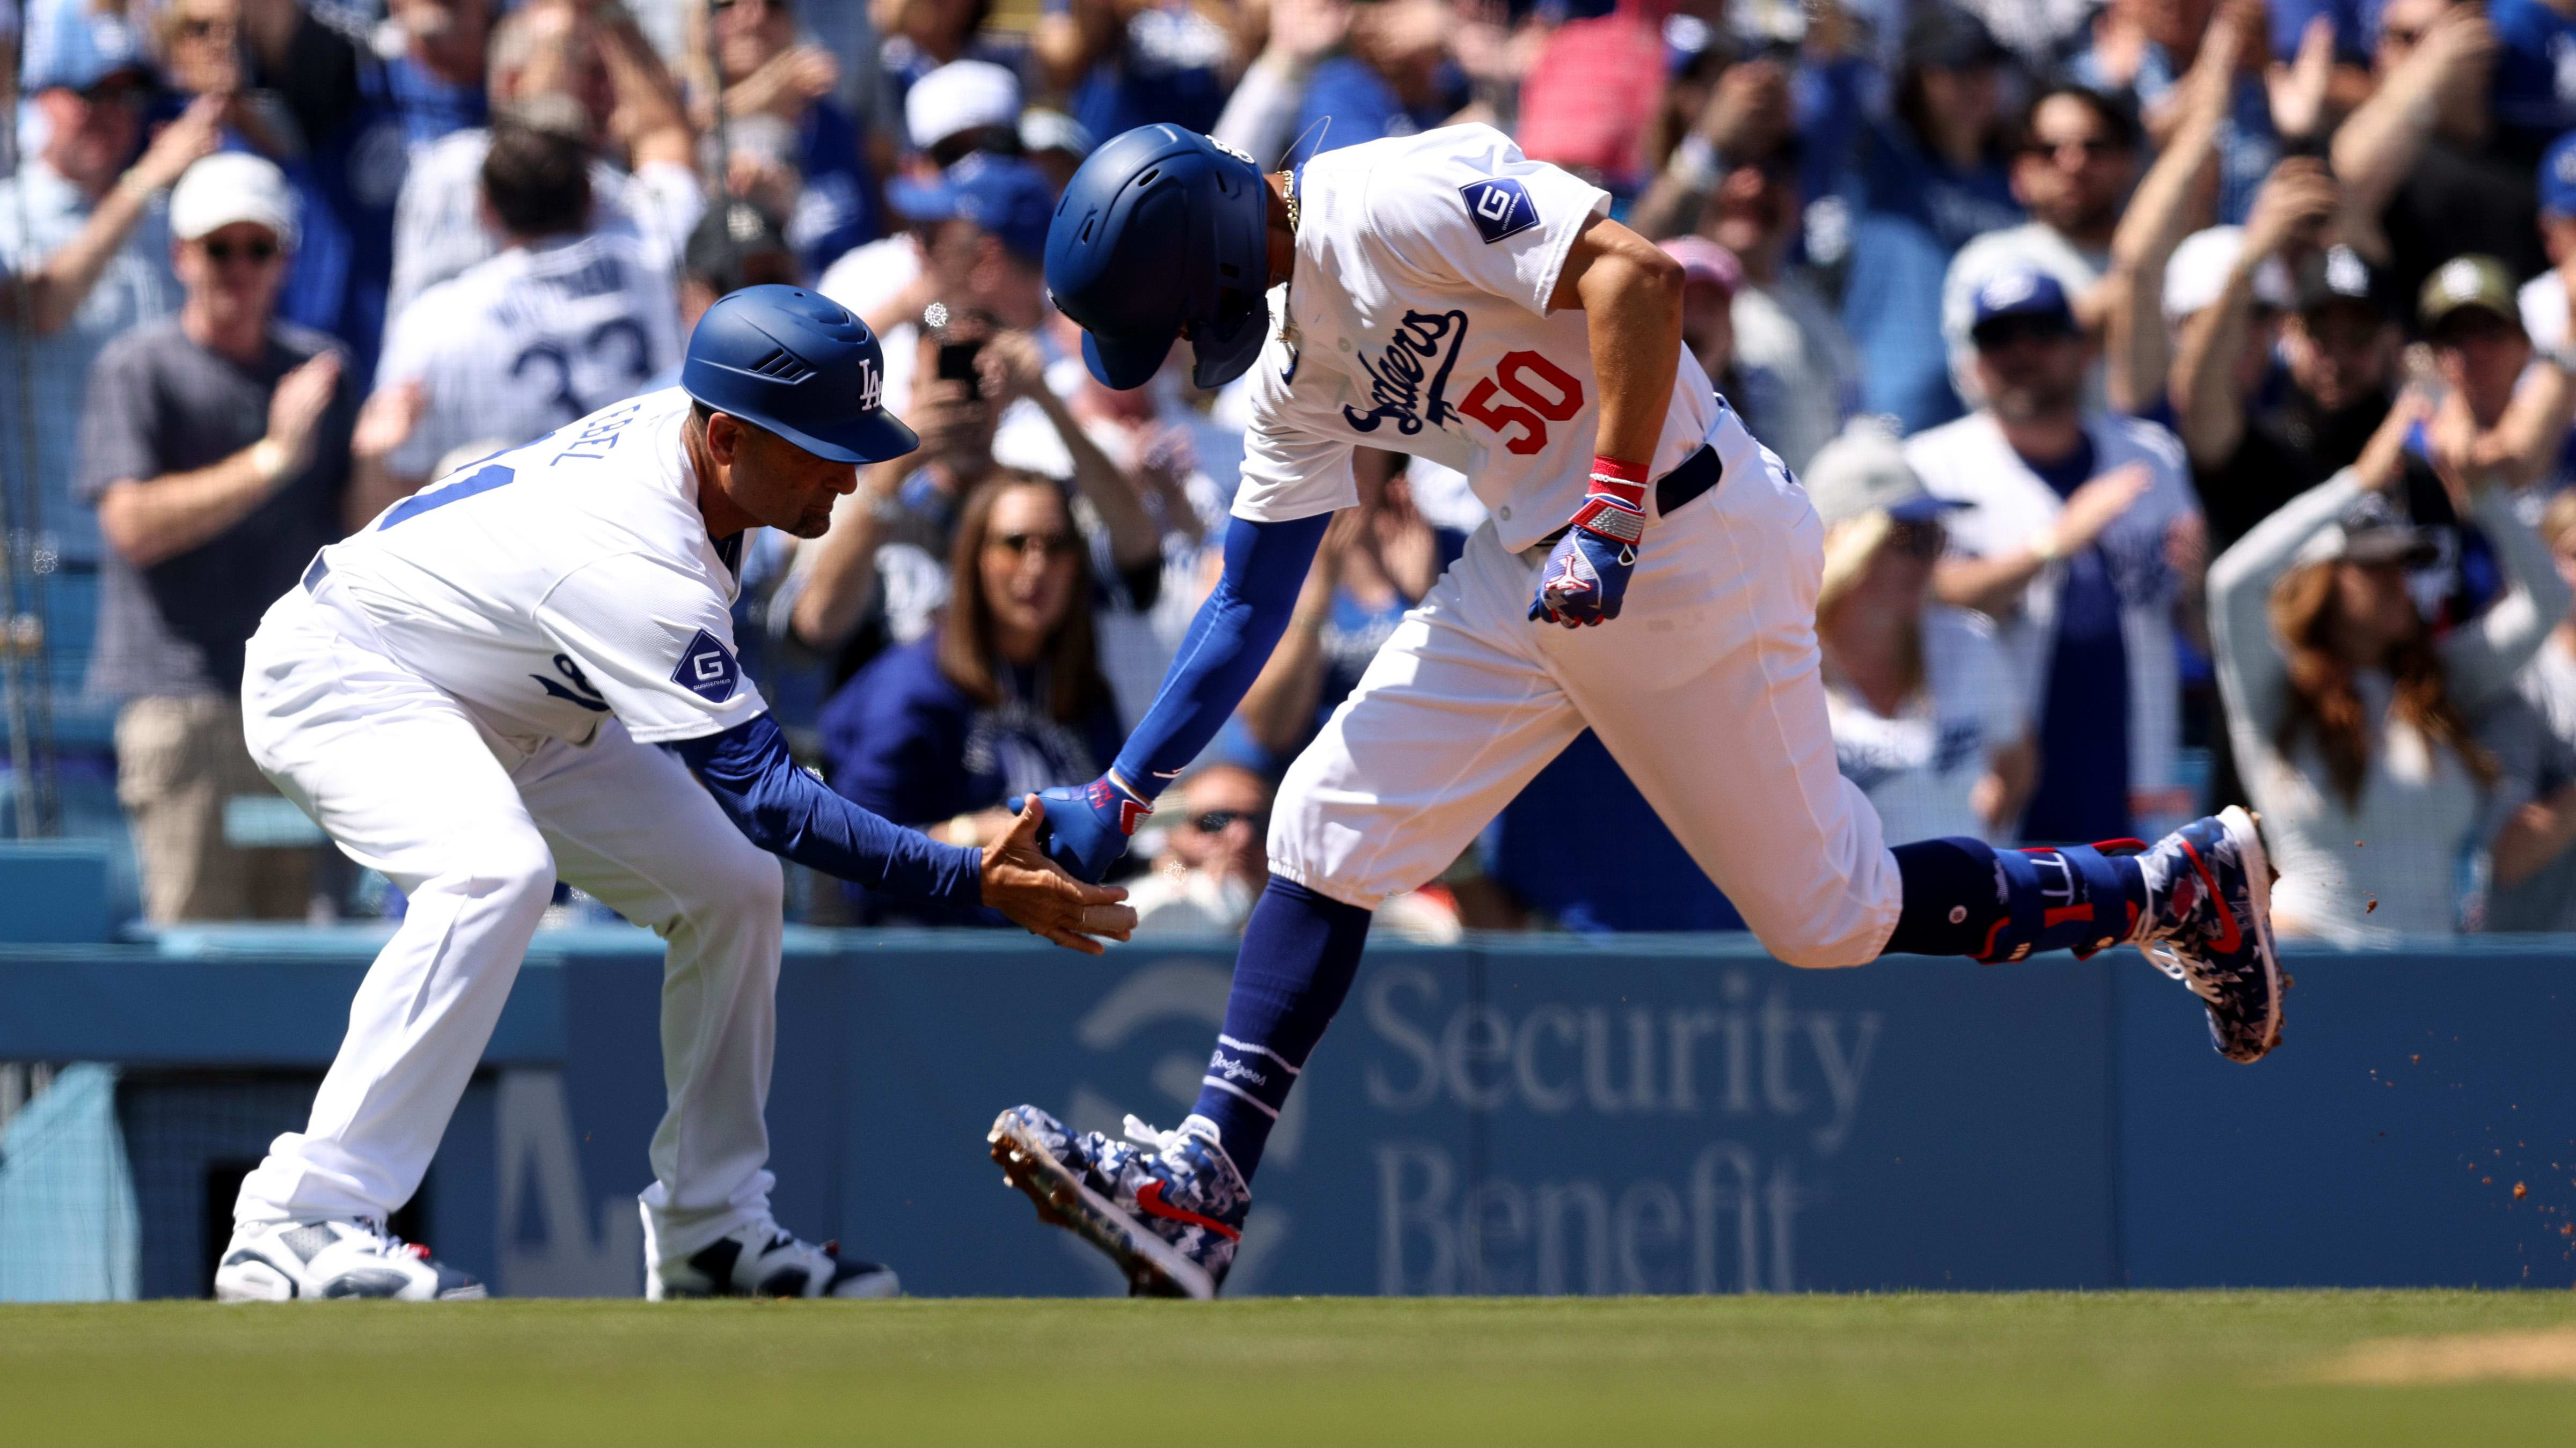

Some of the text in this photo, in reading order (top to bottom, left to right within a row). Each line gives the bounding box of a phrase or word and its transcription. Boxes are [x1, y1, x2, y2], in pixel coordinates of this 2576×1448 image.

[1477, 186, 1510, 221] G
[1502, 192, 1521, 231] GUGGENHEIM
[859, 358, 882, 411] LA
[1458, 350, 1584, 455] 50
[693, 650, 723, 681] G
[693, 678, 731, 691] GUGGENHEIM
[1210, 1049, 1267, 1086] Dodgers
[1363, 967, 1883, 1155] Security
[1371, 1141, 1810, 1296] Benefit
